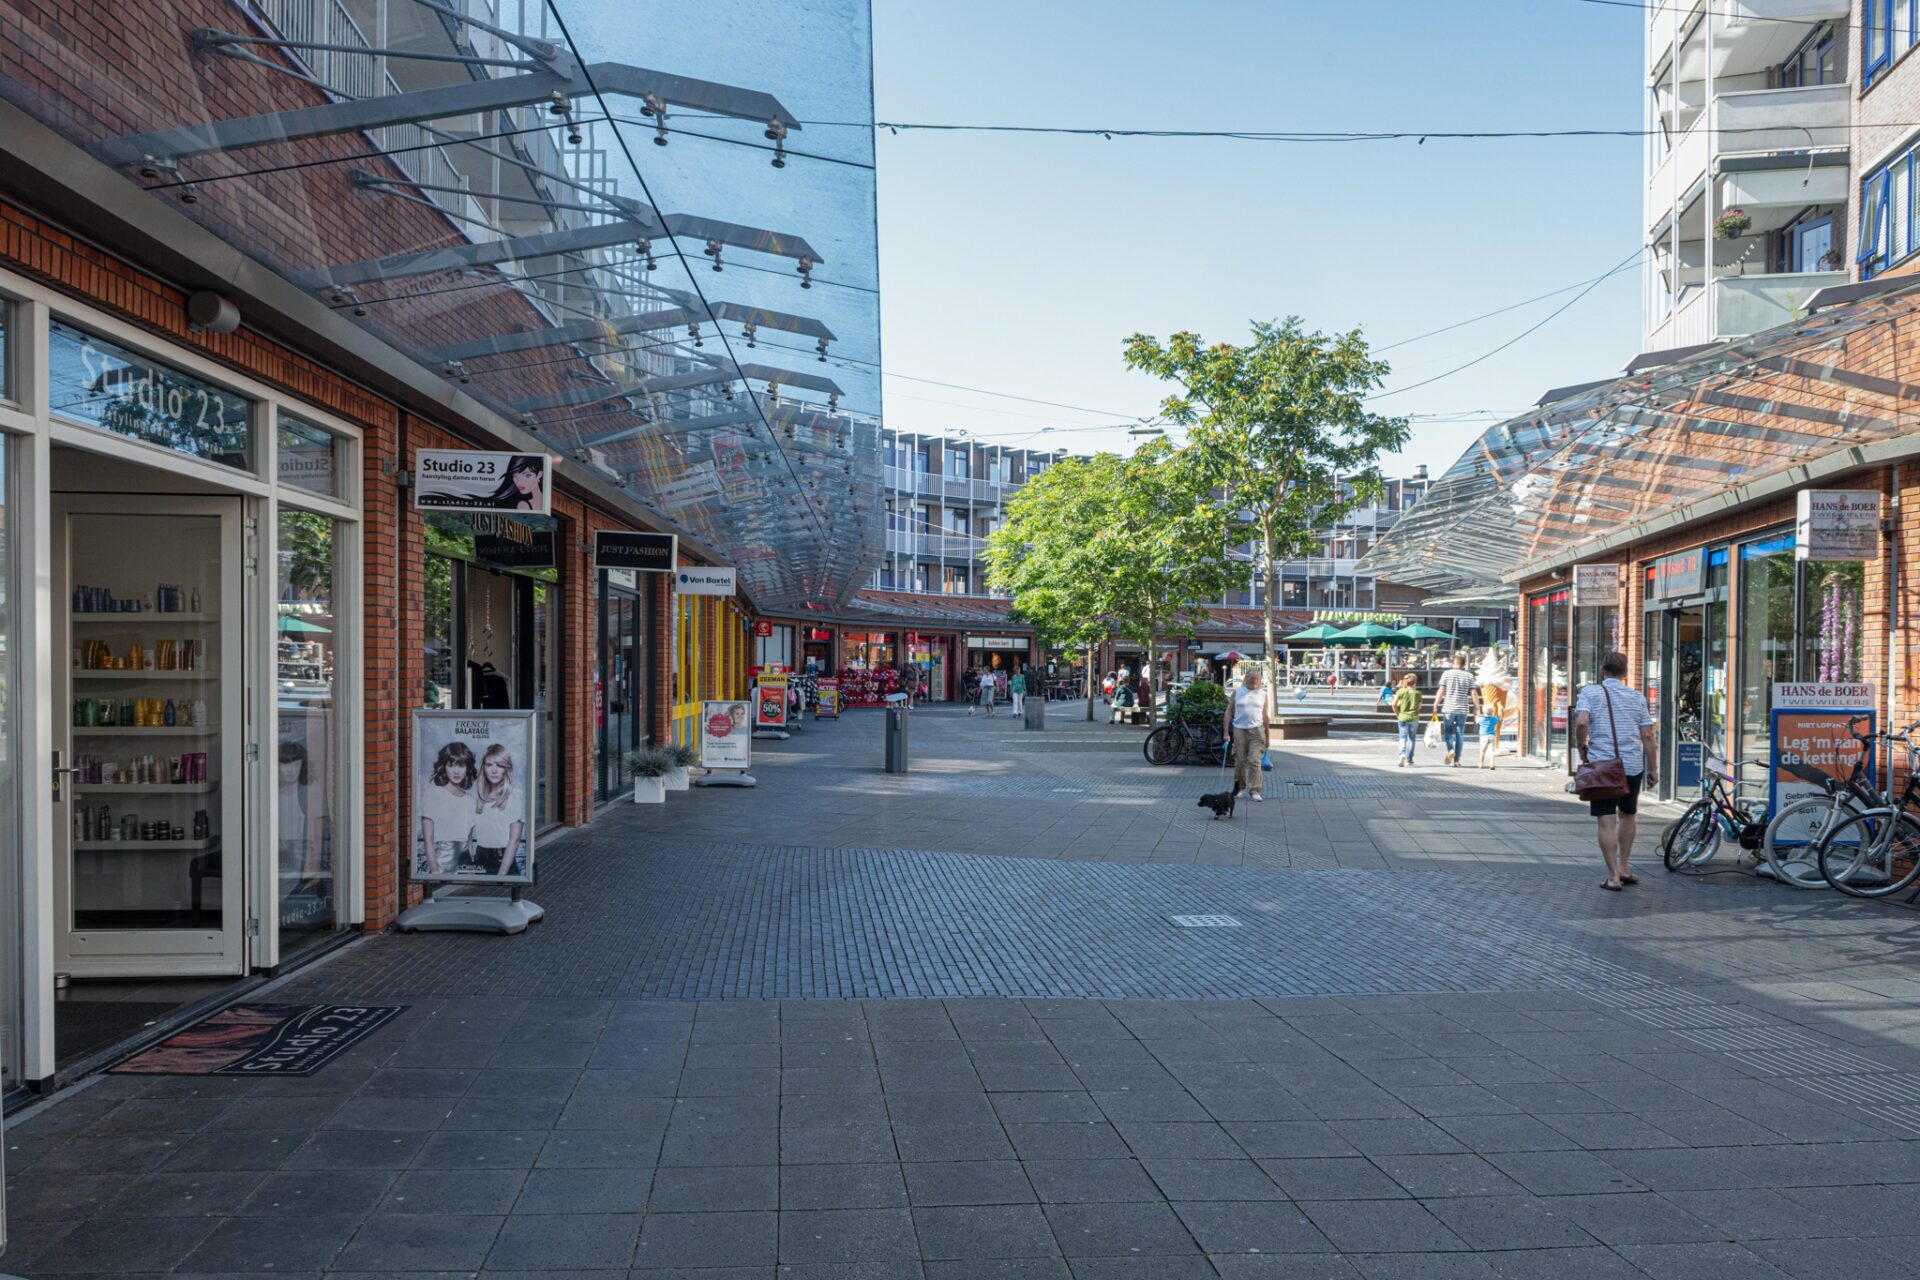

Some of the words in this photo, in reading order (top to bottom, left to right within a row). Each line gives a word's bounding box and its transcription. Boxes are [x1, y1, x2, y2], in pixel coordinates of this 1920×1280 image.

[81, 344, 182, 420] Studio
[197, 389, 224, 434] 23
[422, 459, 473, 473] Studio
[477, 461, 496, 474] 23
[1812, 502, 1838, 510] HANS
[1840, 502, 1850, 510] de
[1851, 502, 1876, 511] BOER
[471, 511, 494, 534] JUST
[601, 545, 624, 554] JUST
[624, 546, 670, 557] FASHION
[1781, 686, 1815, 696] HANS
[1818, 686, 1832, 696] de
[1834, 686, 1869, 696] BOER
[762, 703, 781, 713] 50%
[1783, 736, 1809, 751] Leg
[1834, 739, 1860, 749] aan
[1781, 751, 1800, 765] de
[1785, 792, 1814, 800] Gebrui
[242, 1026, 340, 1070] Studio
[321, 1007, 368, 1022] 23
